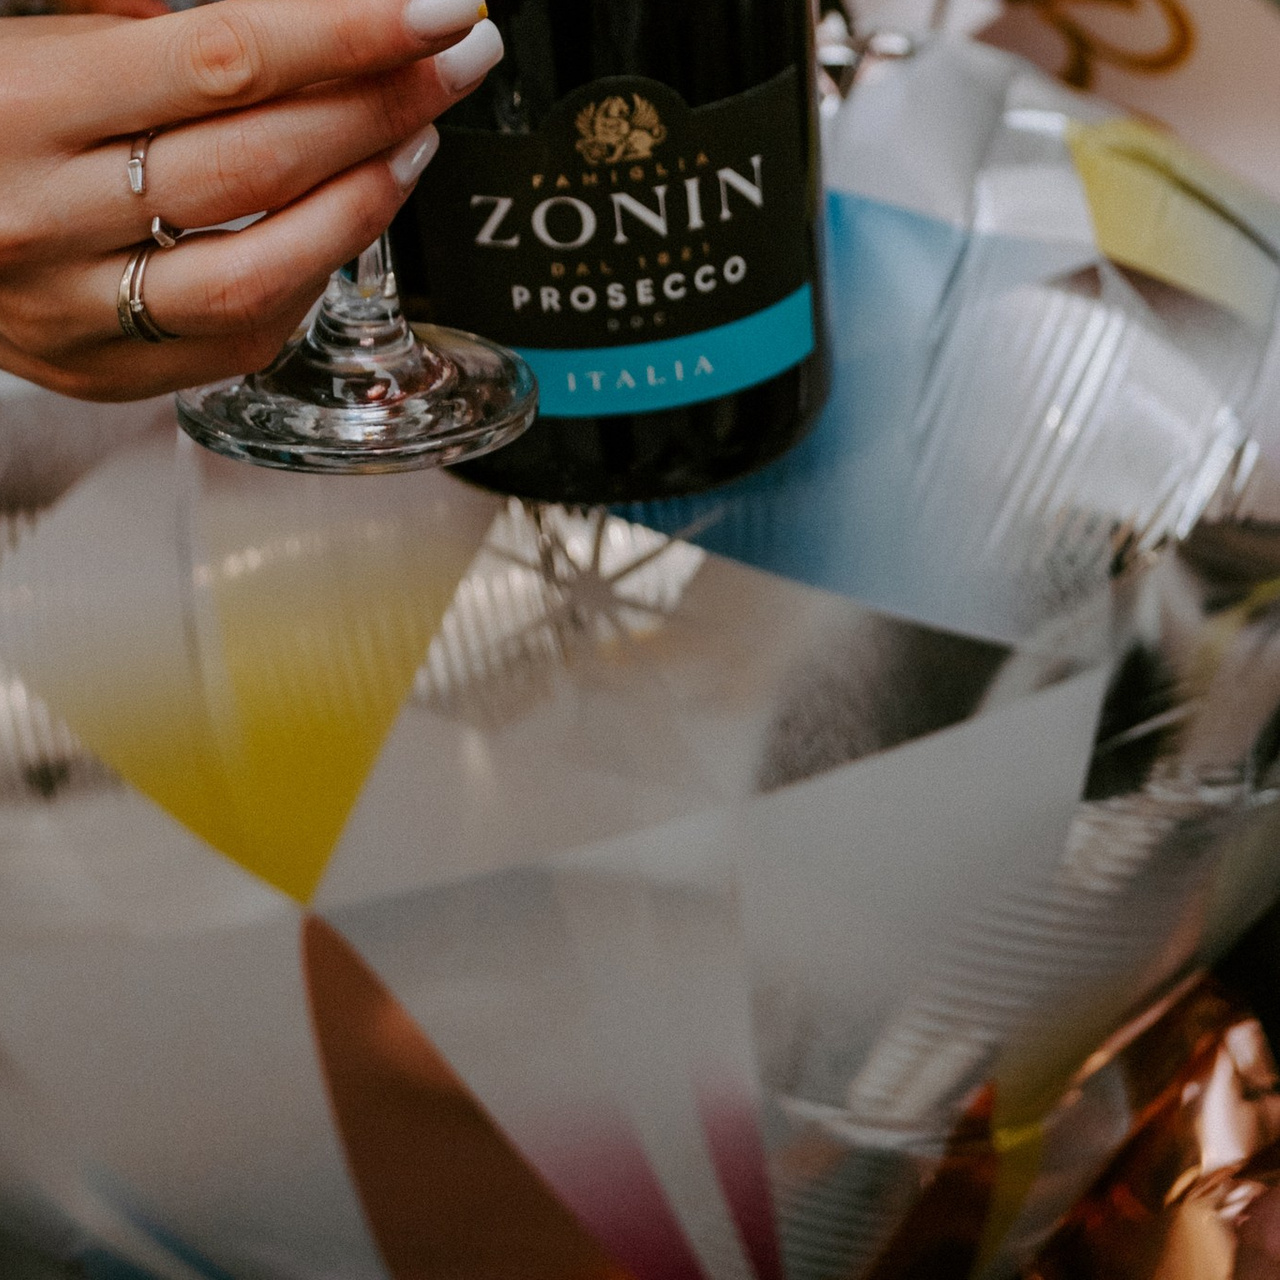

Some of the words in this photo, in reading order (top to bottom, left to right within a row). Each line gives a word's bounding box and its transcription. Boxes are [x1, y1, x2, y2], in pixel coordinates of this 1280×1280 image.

[470, 154, 764, 249] ZONIN
[511, 254, 748, 312] PROSECCO
[566, 354, 715, 393] ITALIA
